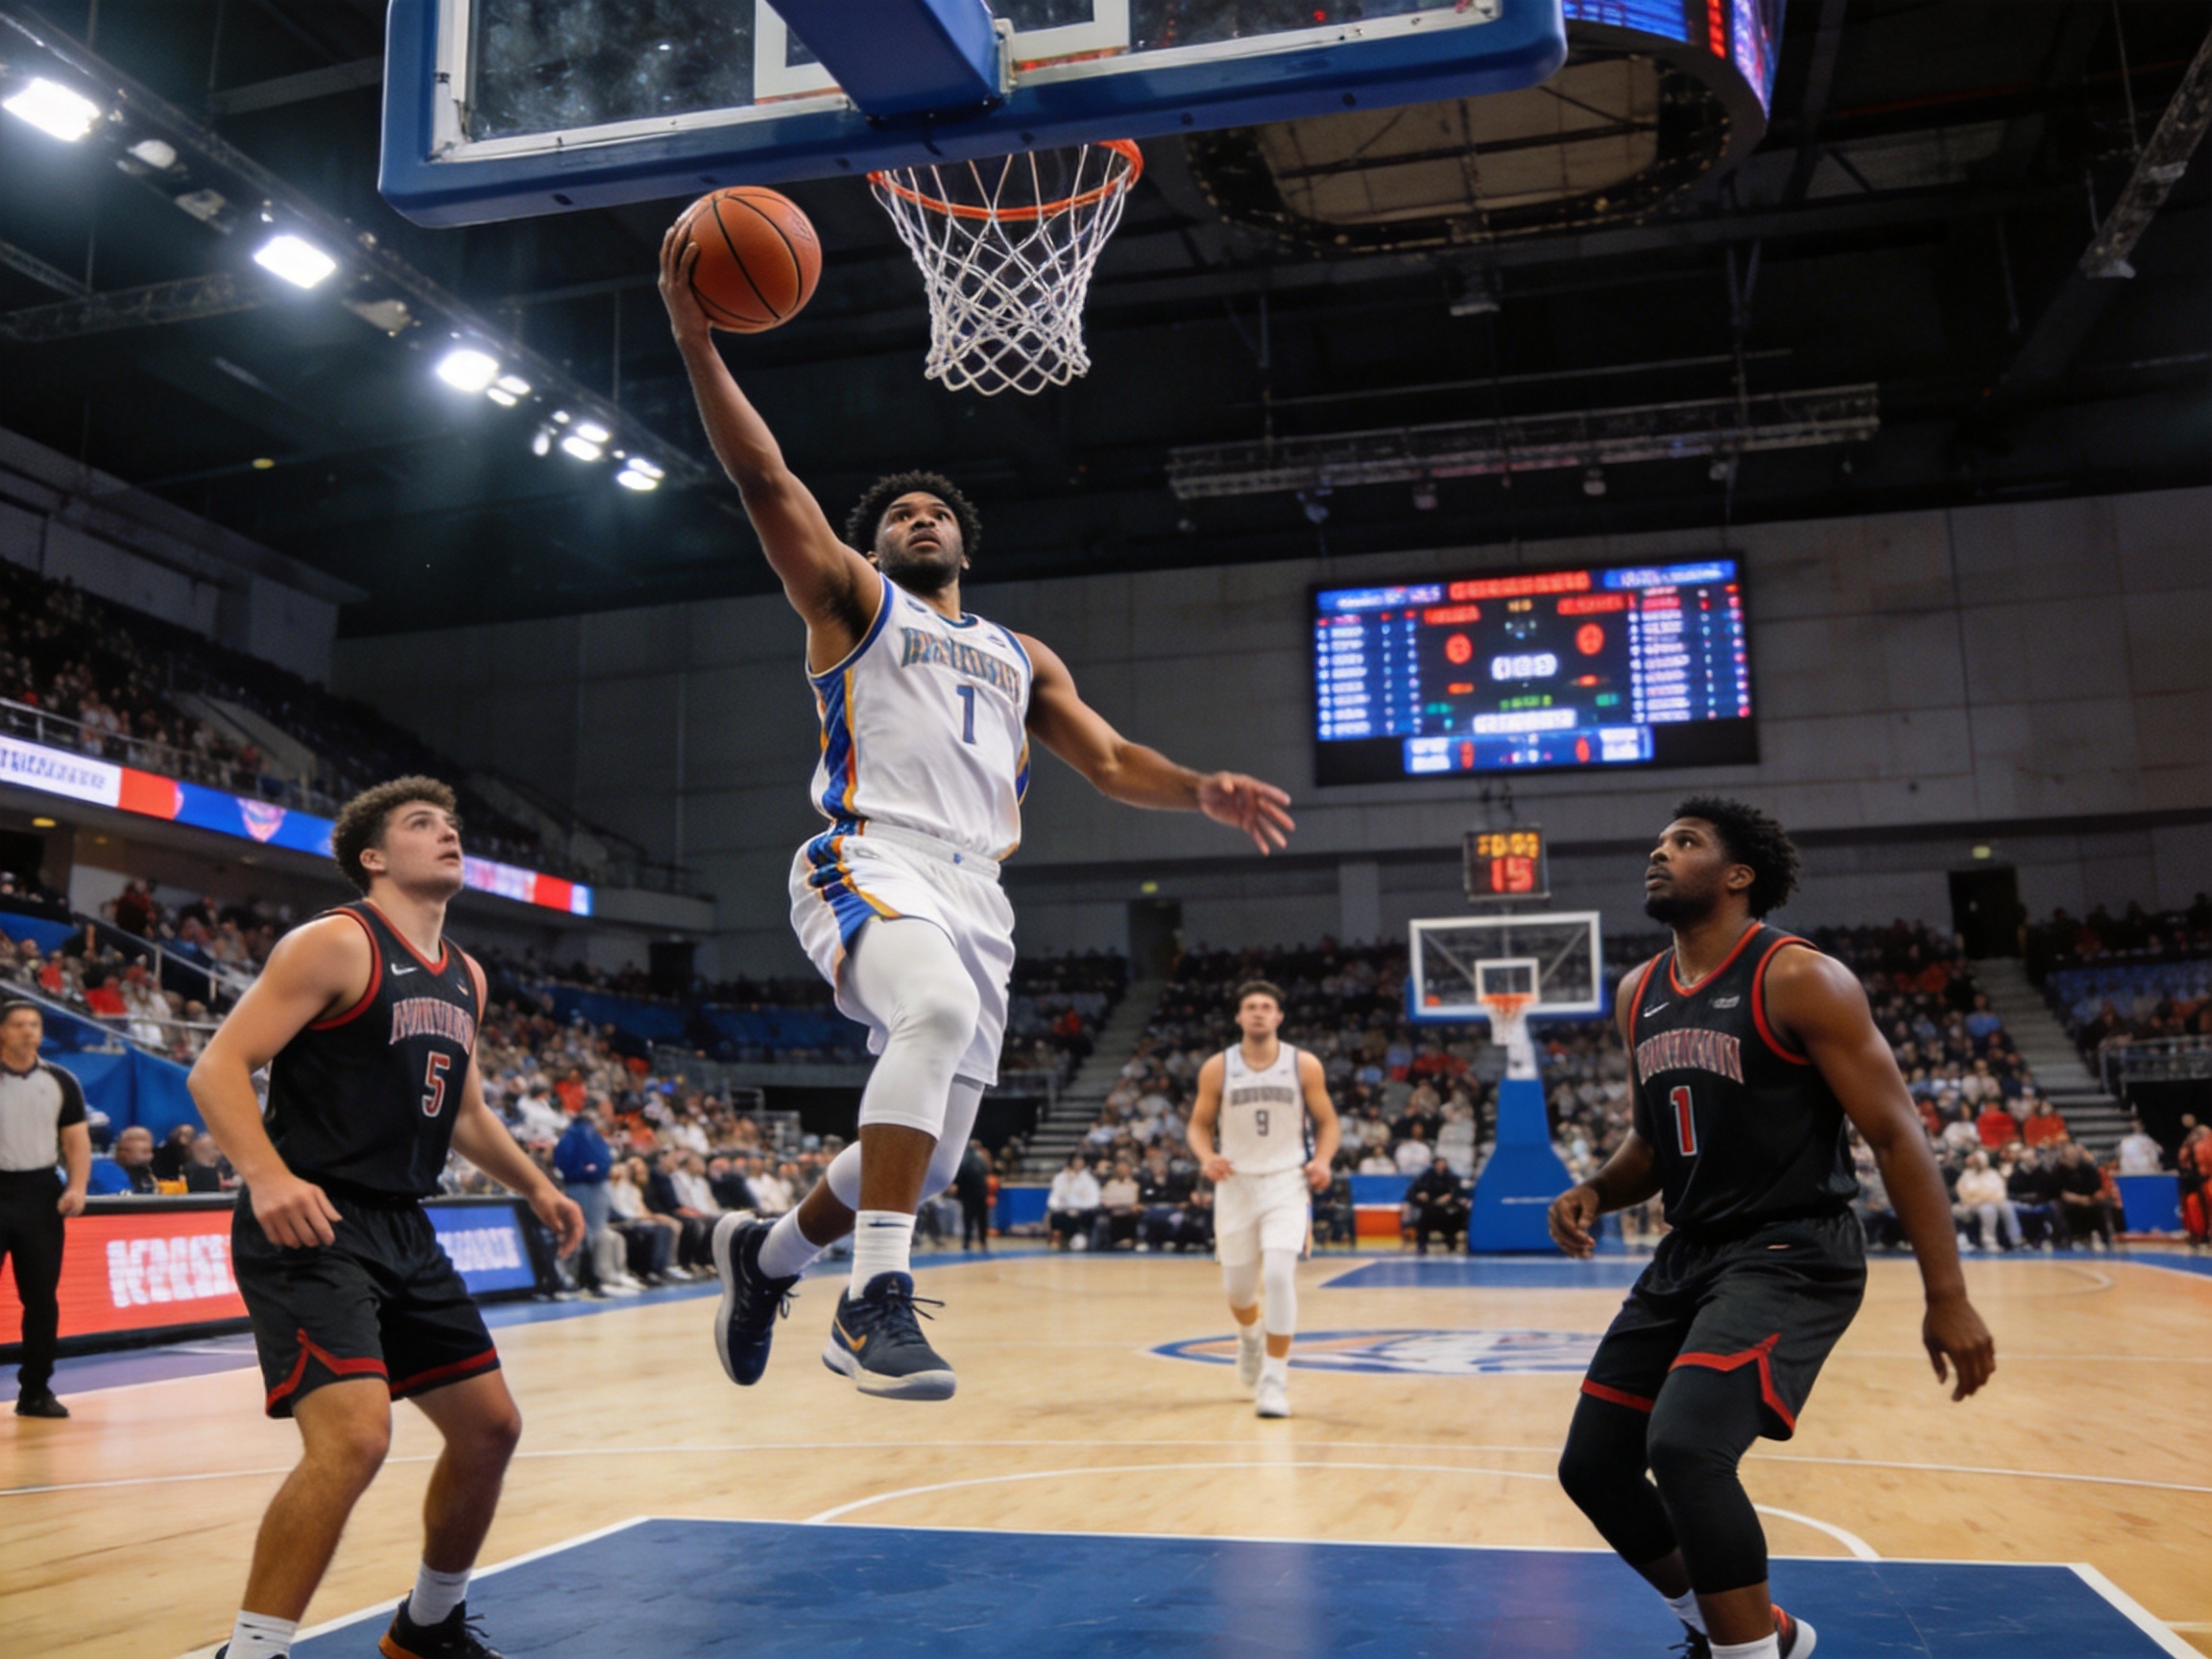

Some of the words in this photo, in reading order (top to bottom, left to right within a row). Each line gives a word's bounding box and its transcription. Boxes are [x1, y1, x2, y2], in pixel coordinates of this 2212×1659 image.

[956, 685, 976, 745] 1
[1491, 857, 1534, 893] 15
[421, 1050, 450, 1118] 5
[1255, 1109, 1269, 1137] 9
[1670, 1085, 1697, 1157] 1
